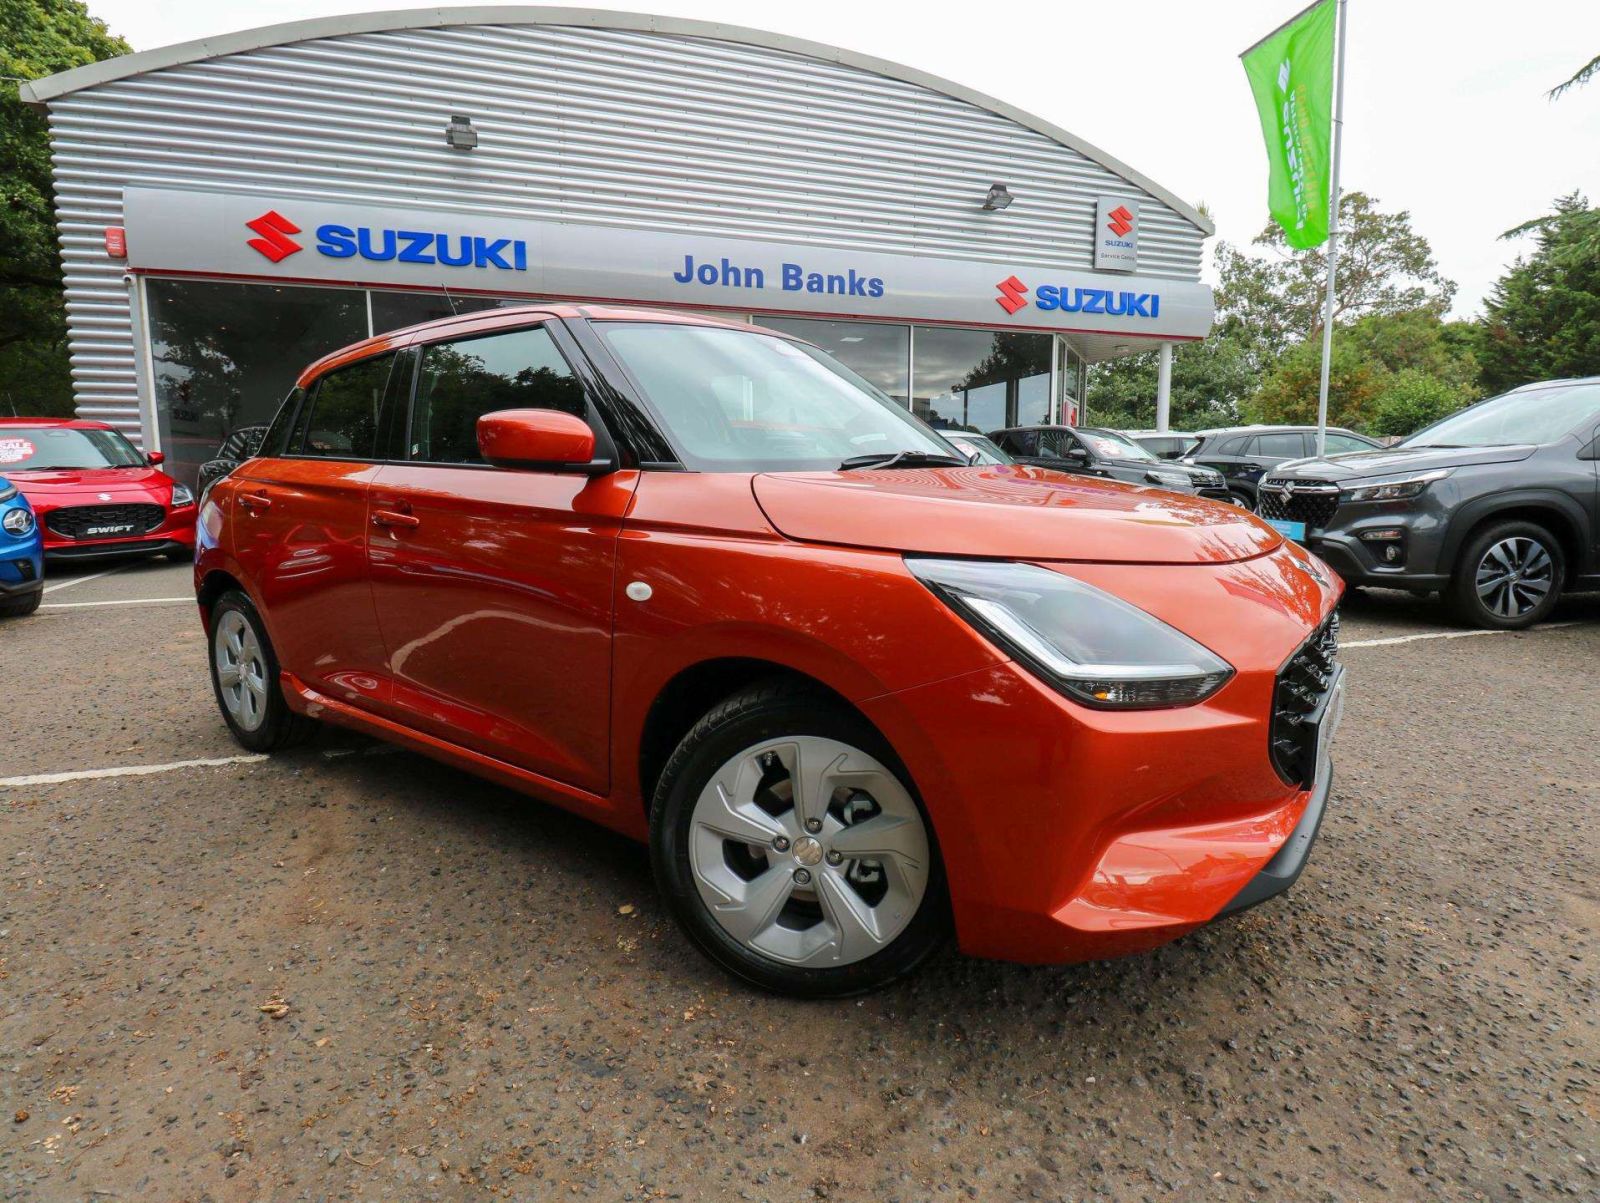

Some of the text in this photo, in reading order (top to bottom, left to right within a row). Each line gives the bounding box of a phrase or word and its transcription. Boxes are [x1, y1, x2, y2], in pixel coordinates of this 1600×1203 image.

[316, 224, 527, 271] SUZUKI
[1104, 239, 1134, 248] SUZUKI
[673, 255, 884, 298] John Banks
[1035, 284, 1160, 318] SUZUKI
[87, 525, 134, 535] SWIFT
